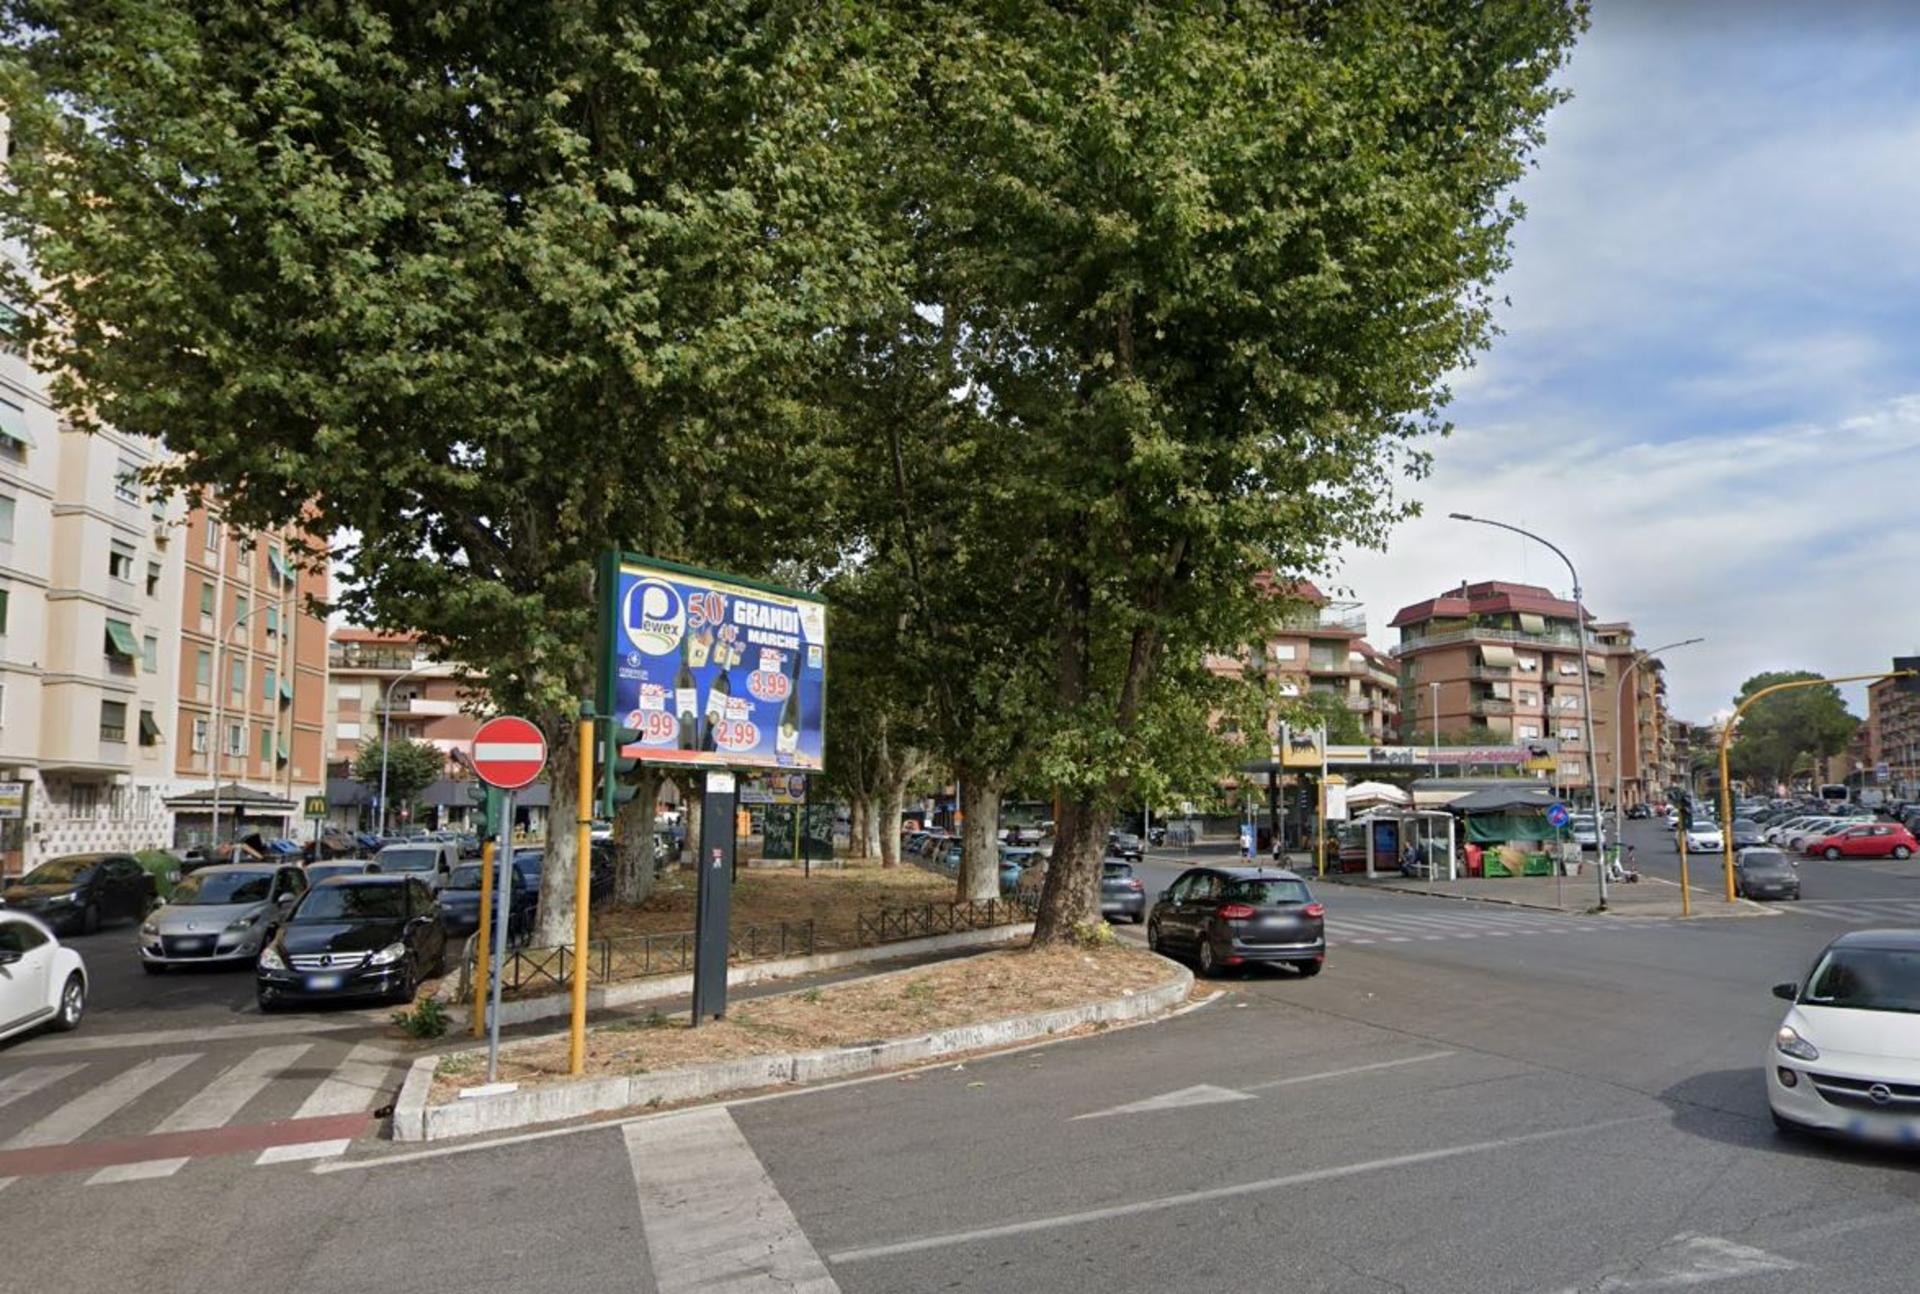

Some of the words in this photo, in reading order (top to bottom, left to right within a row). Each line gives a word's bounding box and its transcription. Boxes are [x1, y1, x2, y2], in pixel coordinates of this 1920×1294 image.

[629, 583, 680, 636] Pewex
[734, 600, 799, 634] GRANDI
[747, 629, 800, 650] MARCHE
[717, 720, 755, 748] 2,99
